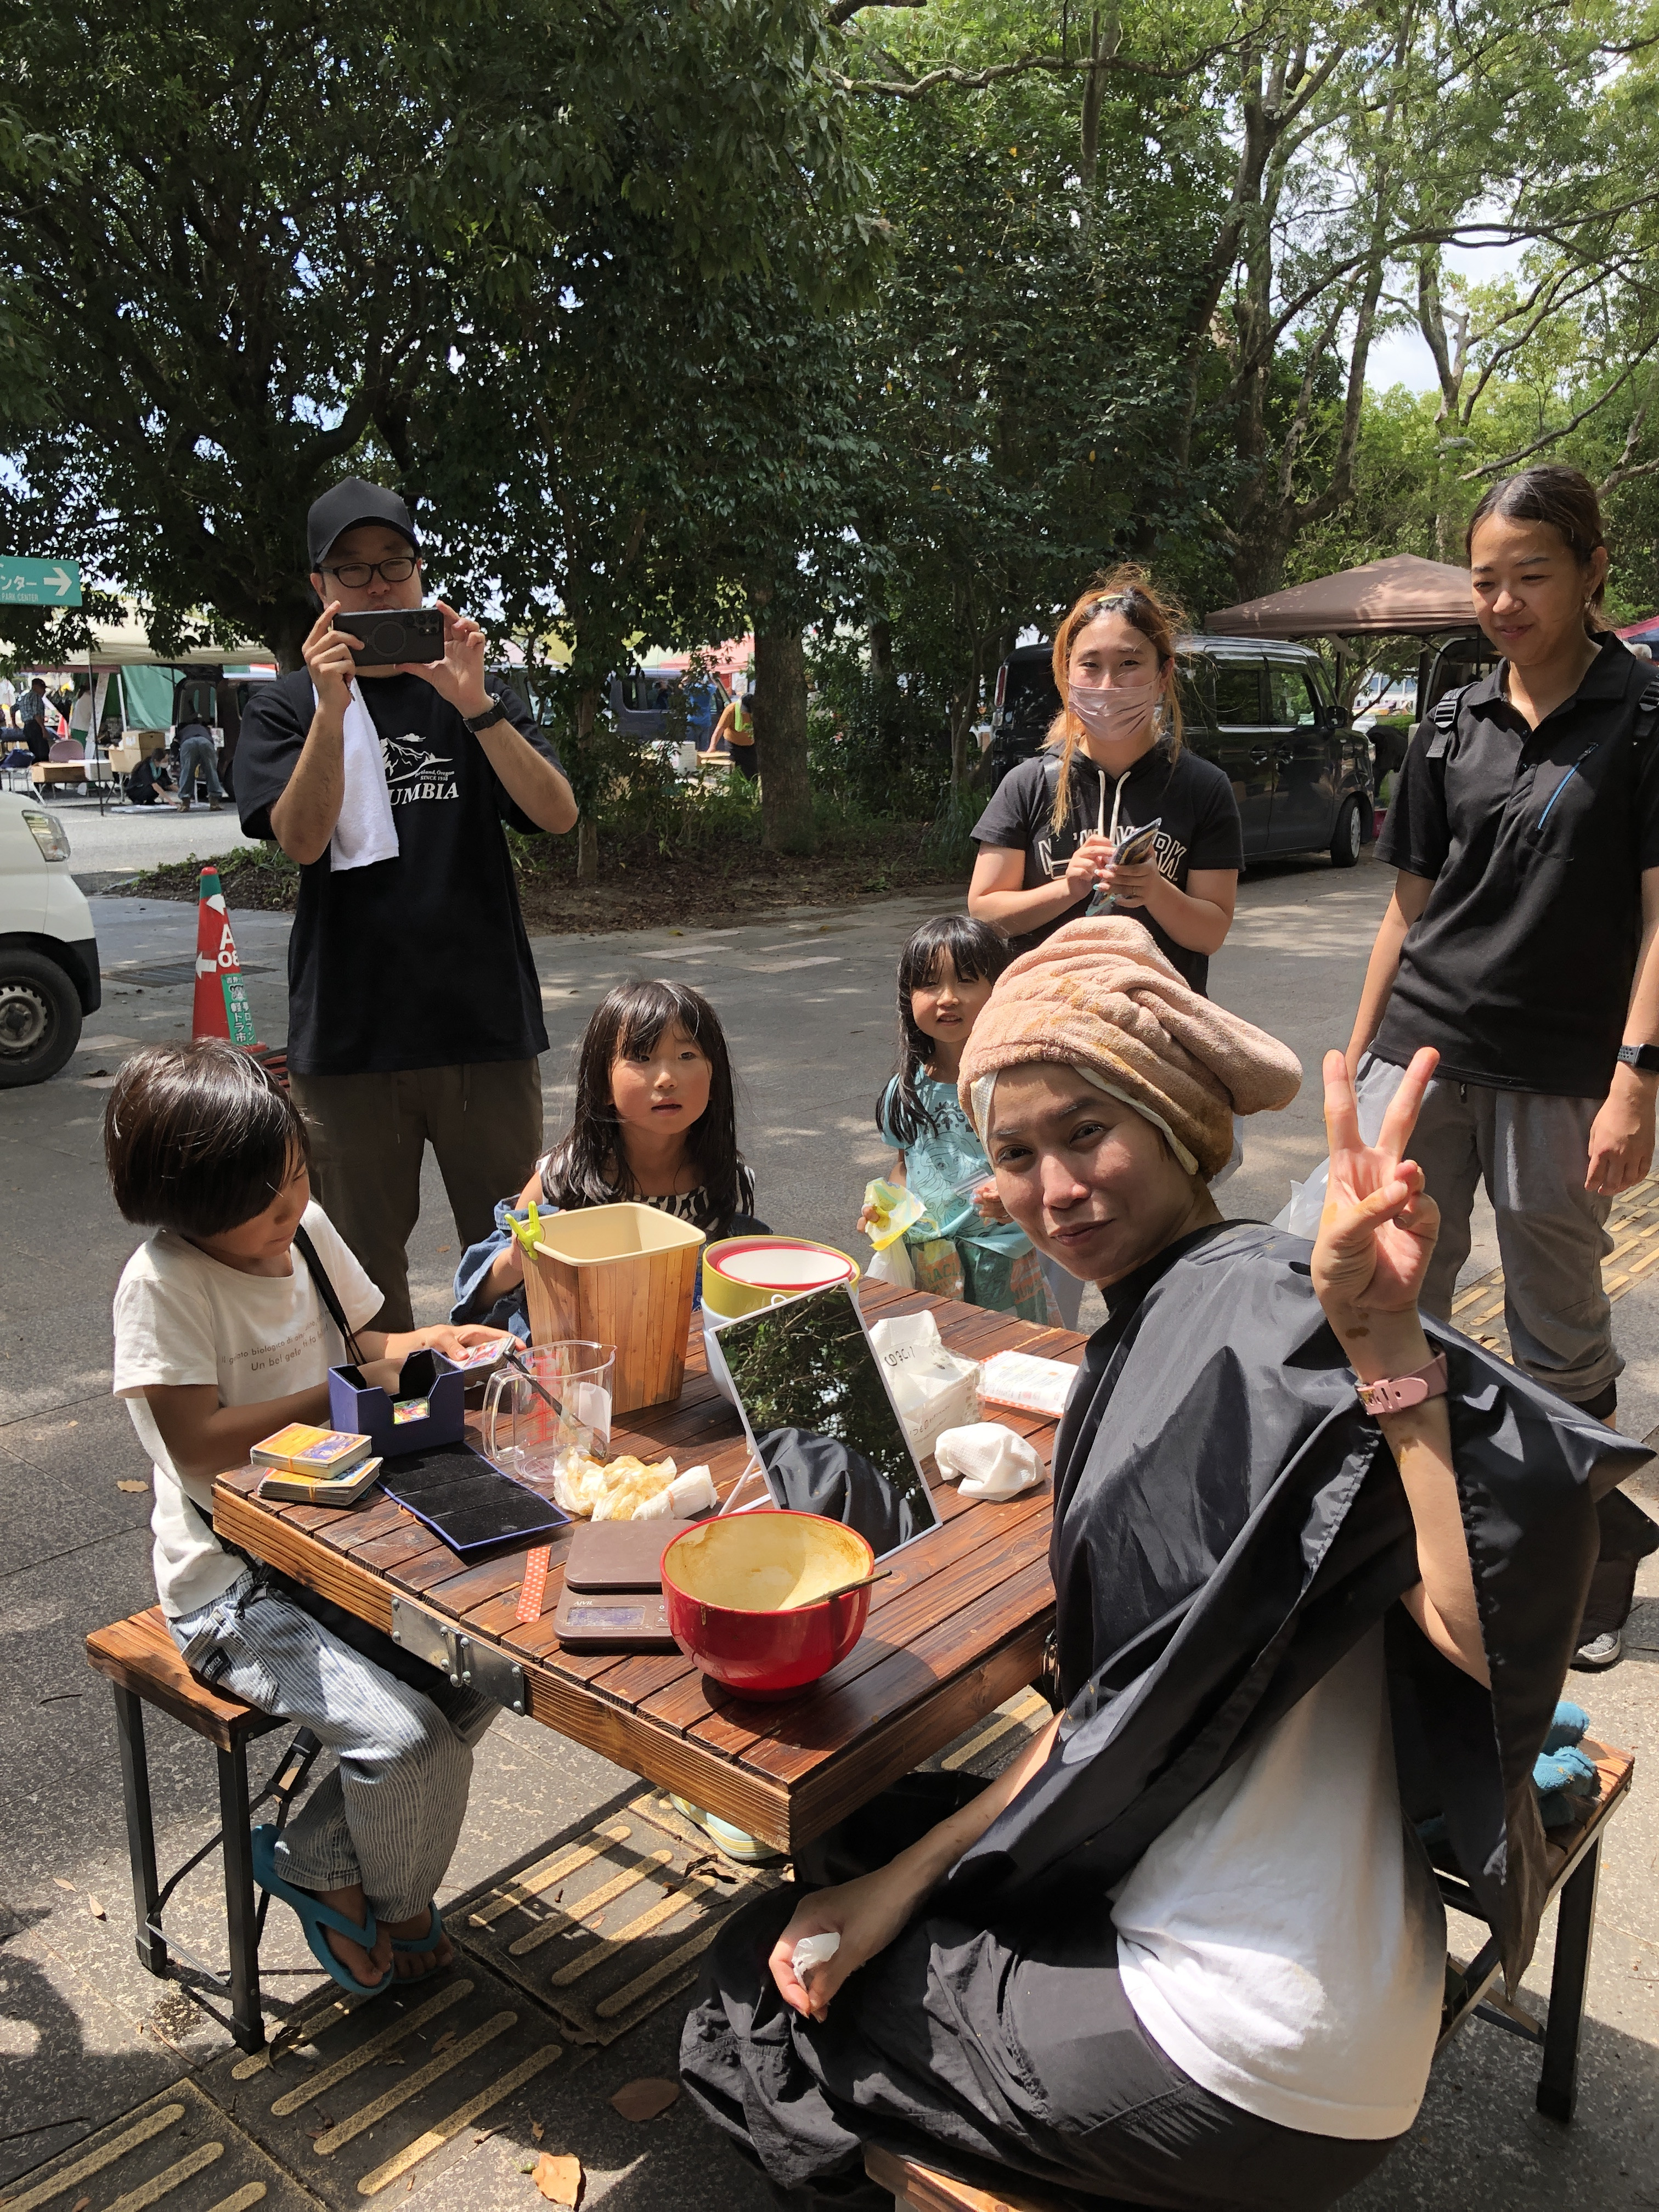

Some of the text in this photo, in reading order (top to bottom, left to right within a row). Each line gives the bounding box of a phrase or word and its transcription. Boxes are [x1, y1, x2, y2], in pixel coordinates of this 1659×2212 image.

[17, 593, 38, 602] CENTER
[388, 782, 459, 805] UMBIA
[219, 924, 235, 950] A
[251, 1340, 285, 1356] biologico
[251, 1362, 265, 1371] Un
[269, 1354, 283, 1367] bel
